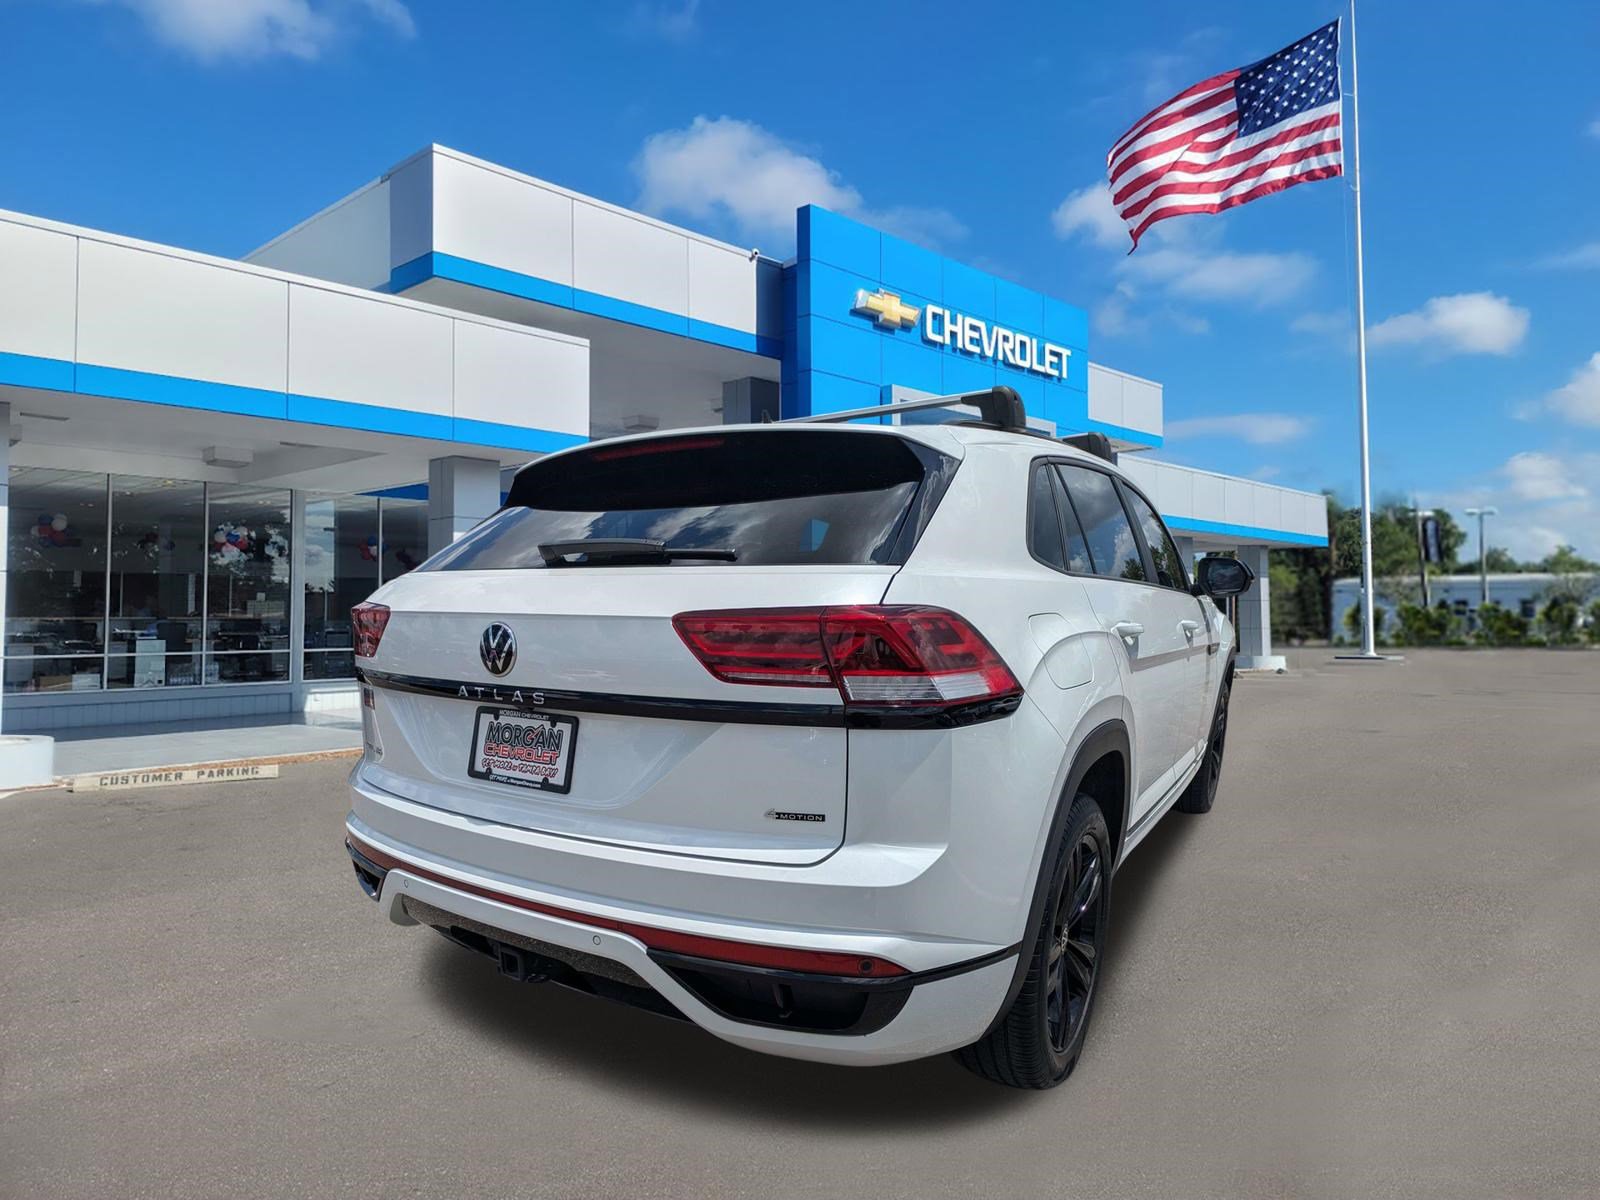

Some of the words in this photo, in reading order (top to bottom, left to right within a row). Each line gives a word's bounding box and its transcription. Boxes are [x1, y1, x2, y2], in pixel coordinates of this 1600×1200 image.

[925, 303, 1072, 379] CHEVROLET
[458, 685, 545, 705] ATLAS
[499, 709, 521, 718] MORGAN
[521, 712, 550, 721] CHEVROLET
[486, 721, 563, 751] MORGAN
[483, 742, 560, 765] CHEVROLET
[99, 772, 184, 787] CUSTOMER
[196, 766, 260, 779] PARKING
